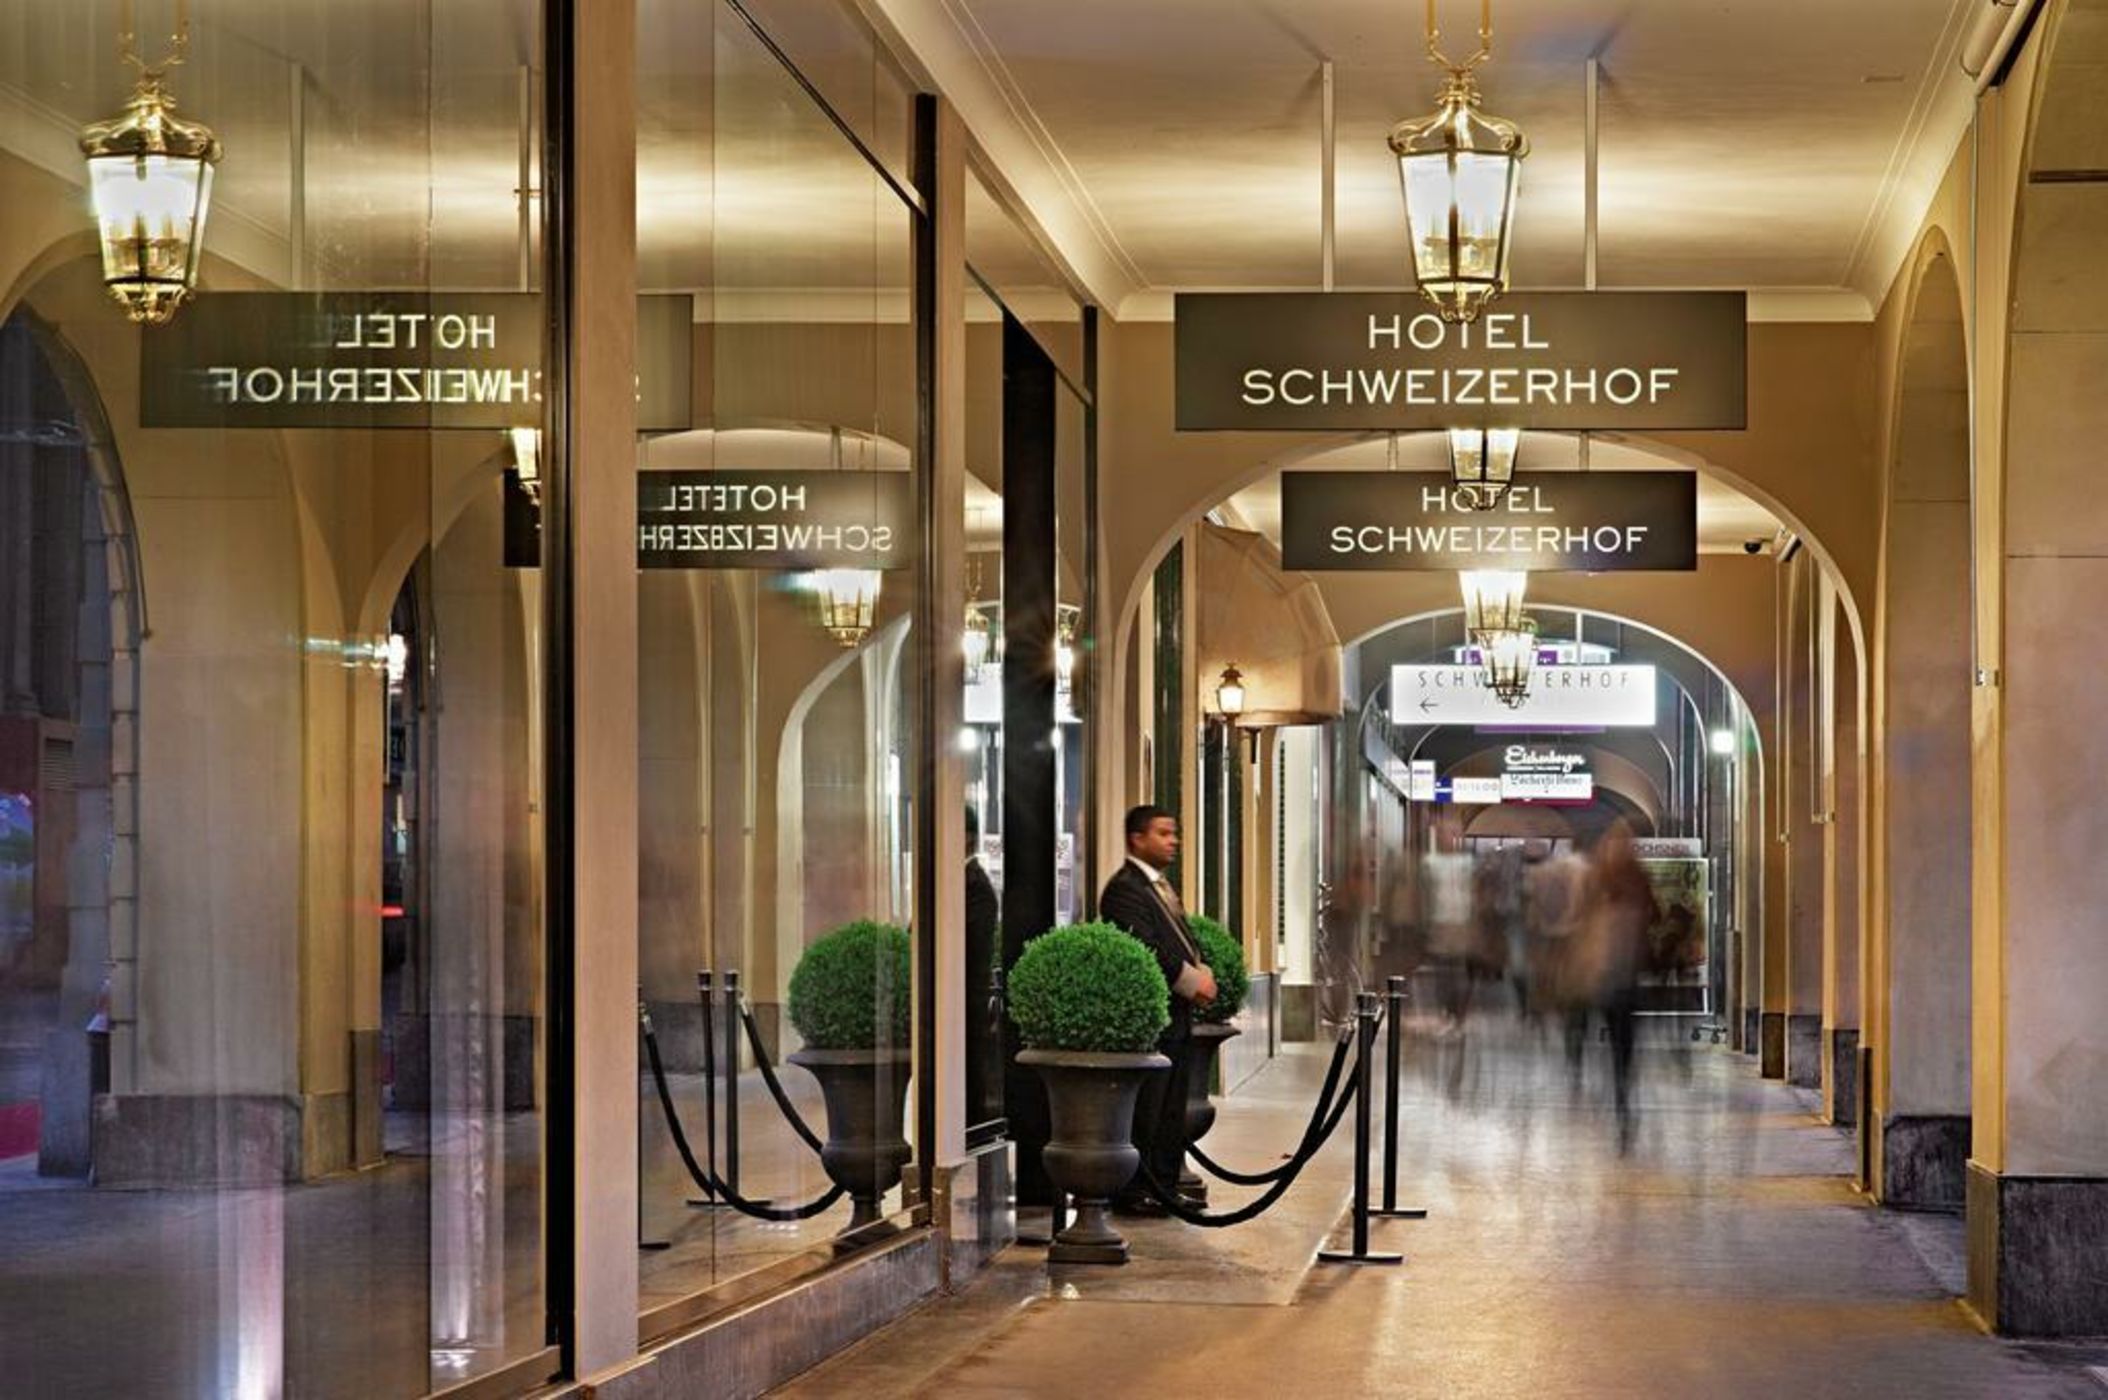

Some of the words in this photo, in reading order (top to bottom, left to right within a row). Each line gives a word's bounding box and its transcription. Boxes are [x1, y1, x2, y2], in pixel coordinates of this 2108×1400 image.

[1242, 368, 1679, 404] SCHWEIZERHOF
[1422, 486, 1555, 512] HOTEL
[1330, 526, 1648, 553] SCHWEIZERHOF
[1418, 671, 1628, 687] SCHWERHOF
